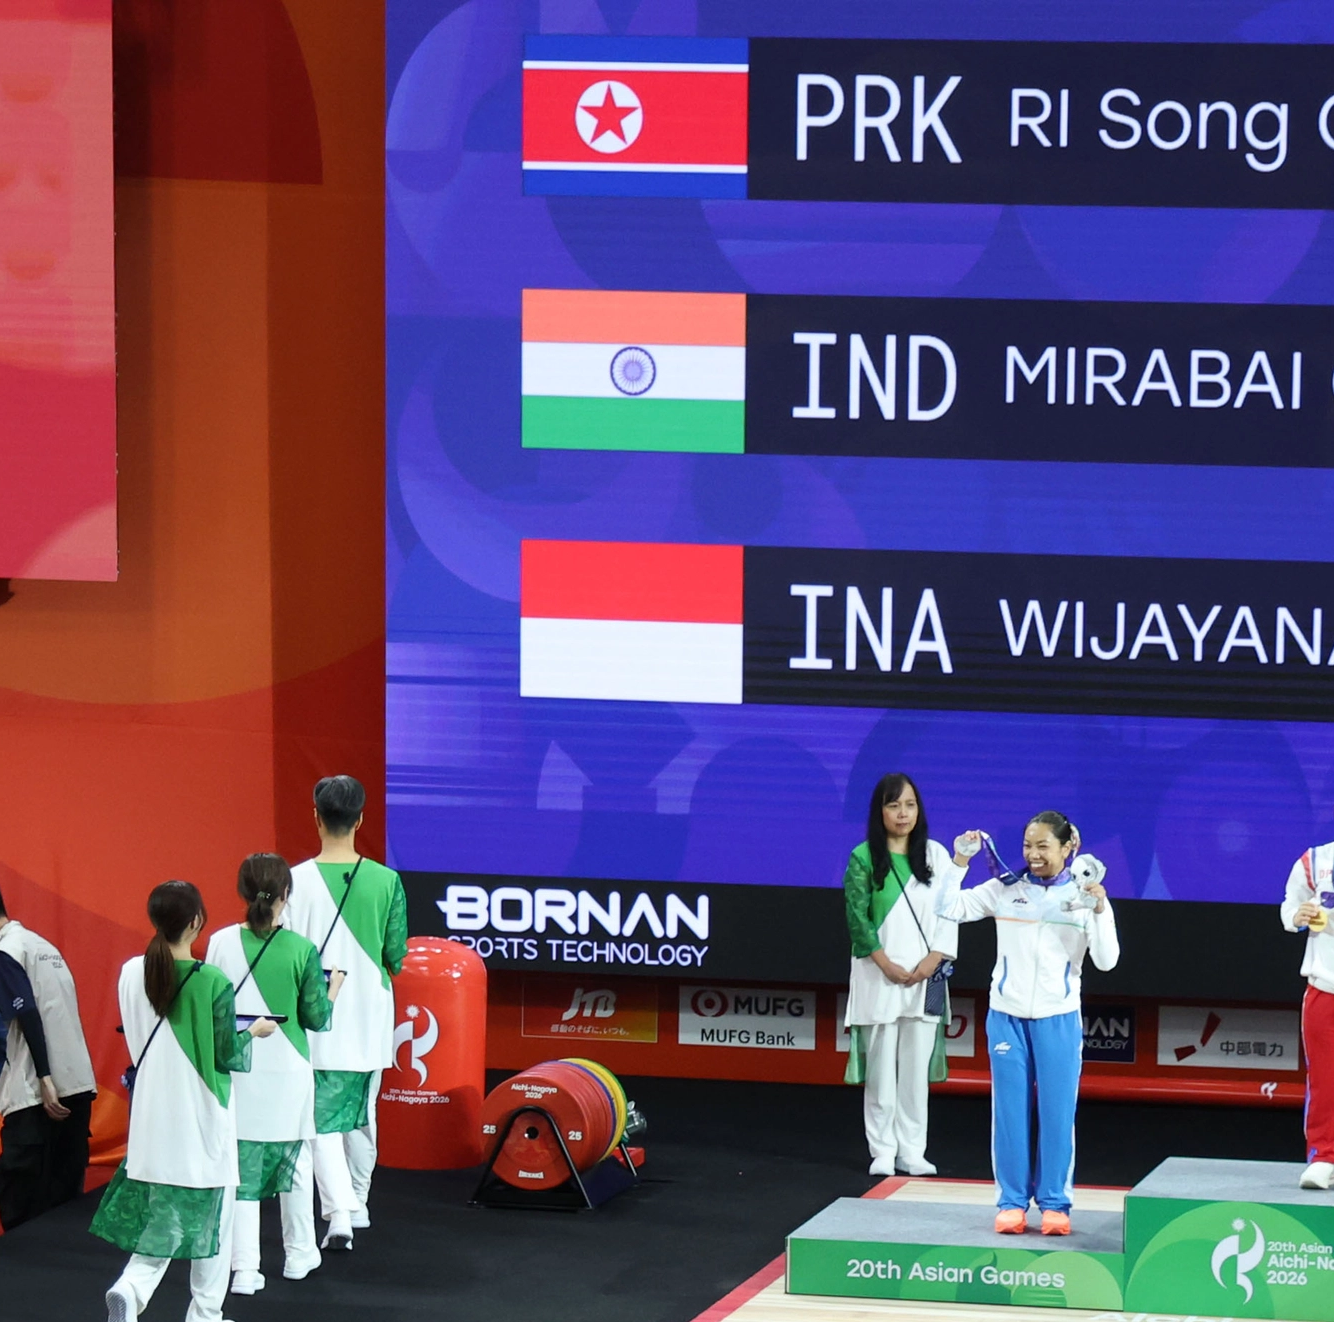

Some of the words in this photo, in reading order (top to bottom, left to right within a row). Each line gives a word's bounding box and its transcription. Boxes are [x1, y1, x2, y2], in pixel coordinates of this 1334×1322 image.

[794, 73, 964, 165] PRK
[1008, 88, 1070, 149] RI
[1097, 89, 1291, 172] Song
[791, 330, 959, 422] IND
[1003, 346, 1304, 411] MIRABAI
[788, 583, 954, 676] INA
[436, 885, 710, 941] BORNAN
[546, 939, 709, 968] TECHNOLOGY
[561, 987, 617, 1021] JTB
[733, 996, 804, 1018] MUFG
[700, 1028, 750, 1045] MUFG
[755, 1031, 795, 1047] Bank
[1219, 1039, 1284, 1058] 中部電力
[482, 1124, 497, 1135] 25
[568, 1130, 583, 1141] 25
[1266, 1240, 1296, 1254] 20th
[1298, 1242, 1333, 1256] Asian
[845, 1258, 902, 1281] 20th
[908, 1260, 974, 1284] Asian
[979, 1264, 1066, 1289] Games
[1266, 1270, 1308, 1286] 2026
